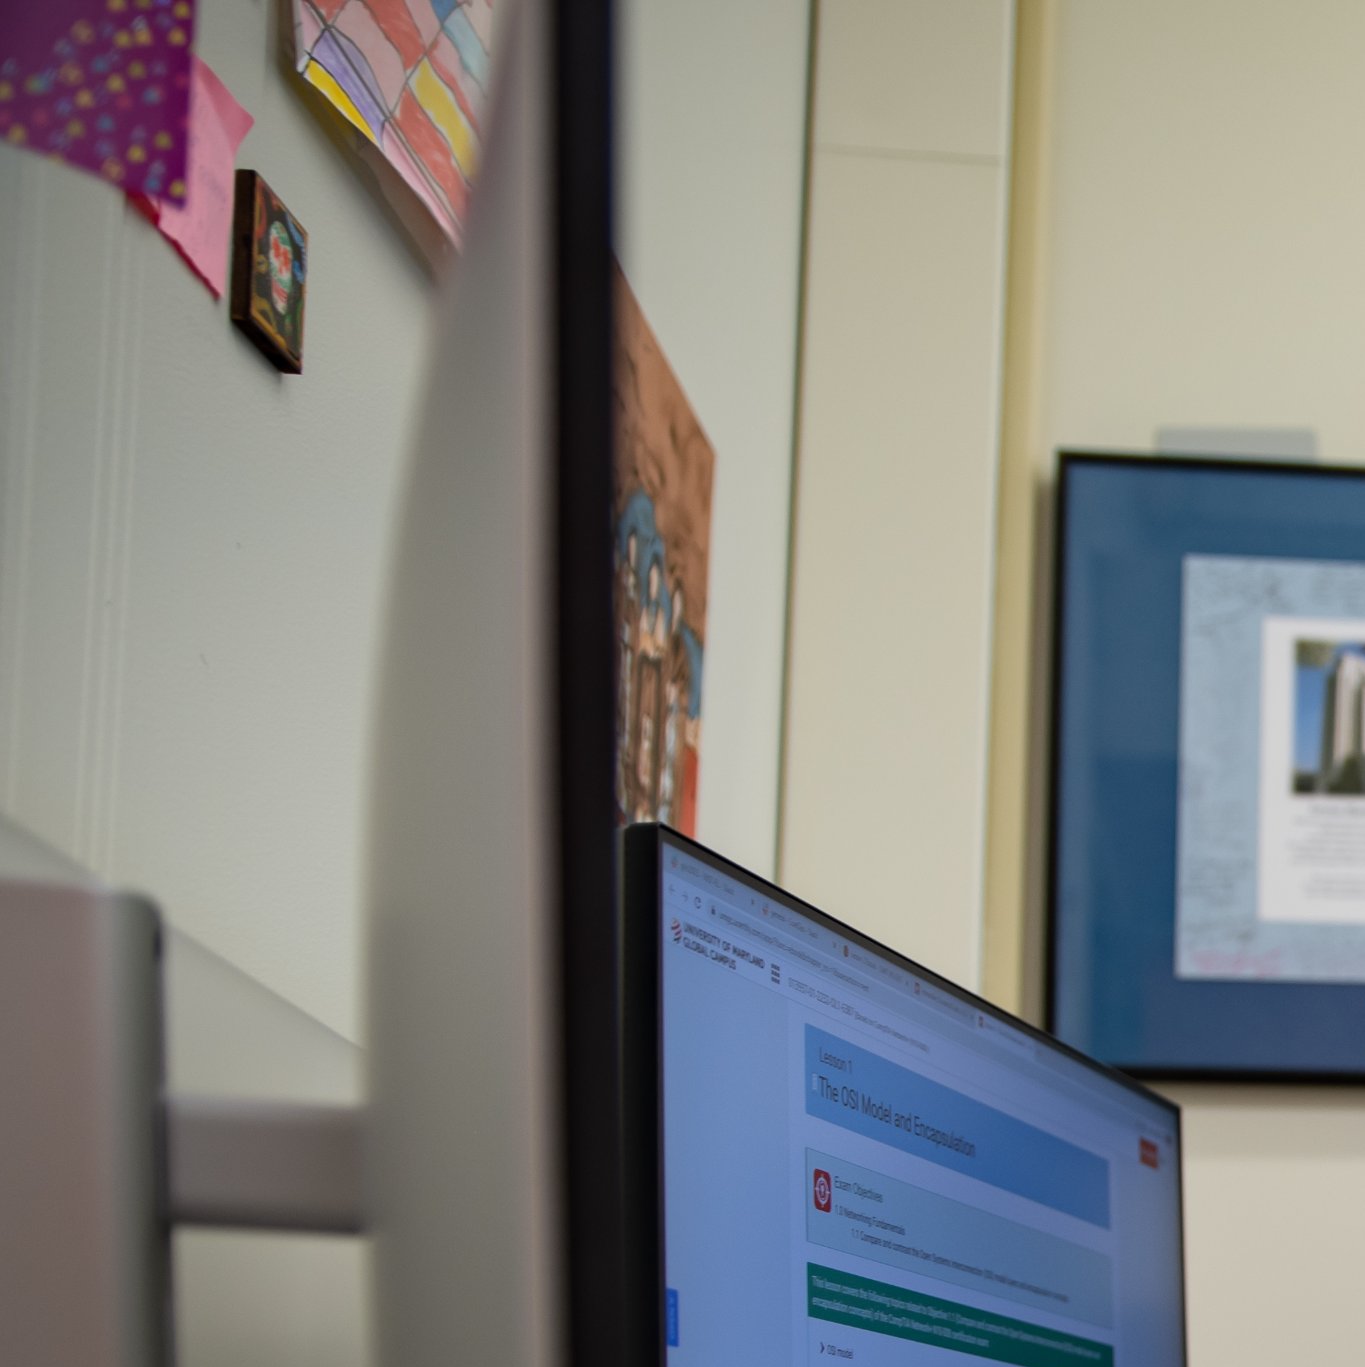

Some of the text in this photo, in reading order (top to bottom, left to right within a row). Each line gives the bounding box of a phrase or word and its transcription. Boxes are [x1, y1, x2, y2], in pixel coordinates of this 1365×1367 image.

[819, 1047, 847, 1071] Lesson
[819, 1075, 976, 1158] The OSI Model and Encapsulation
